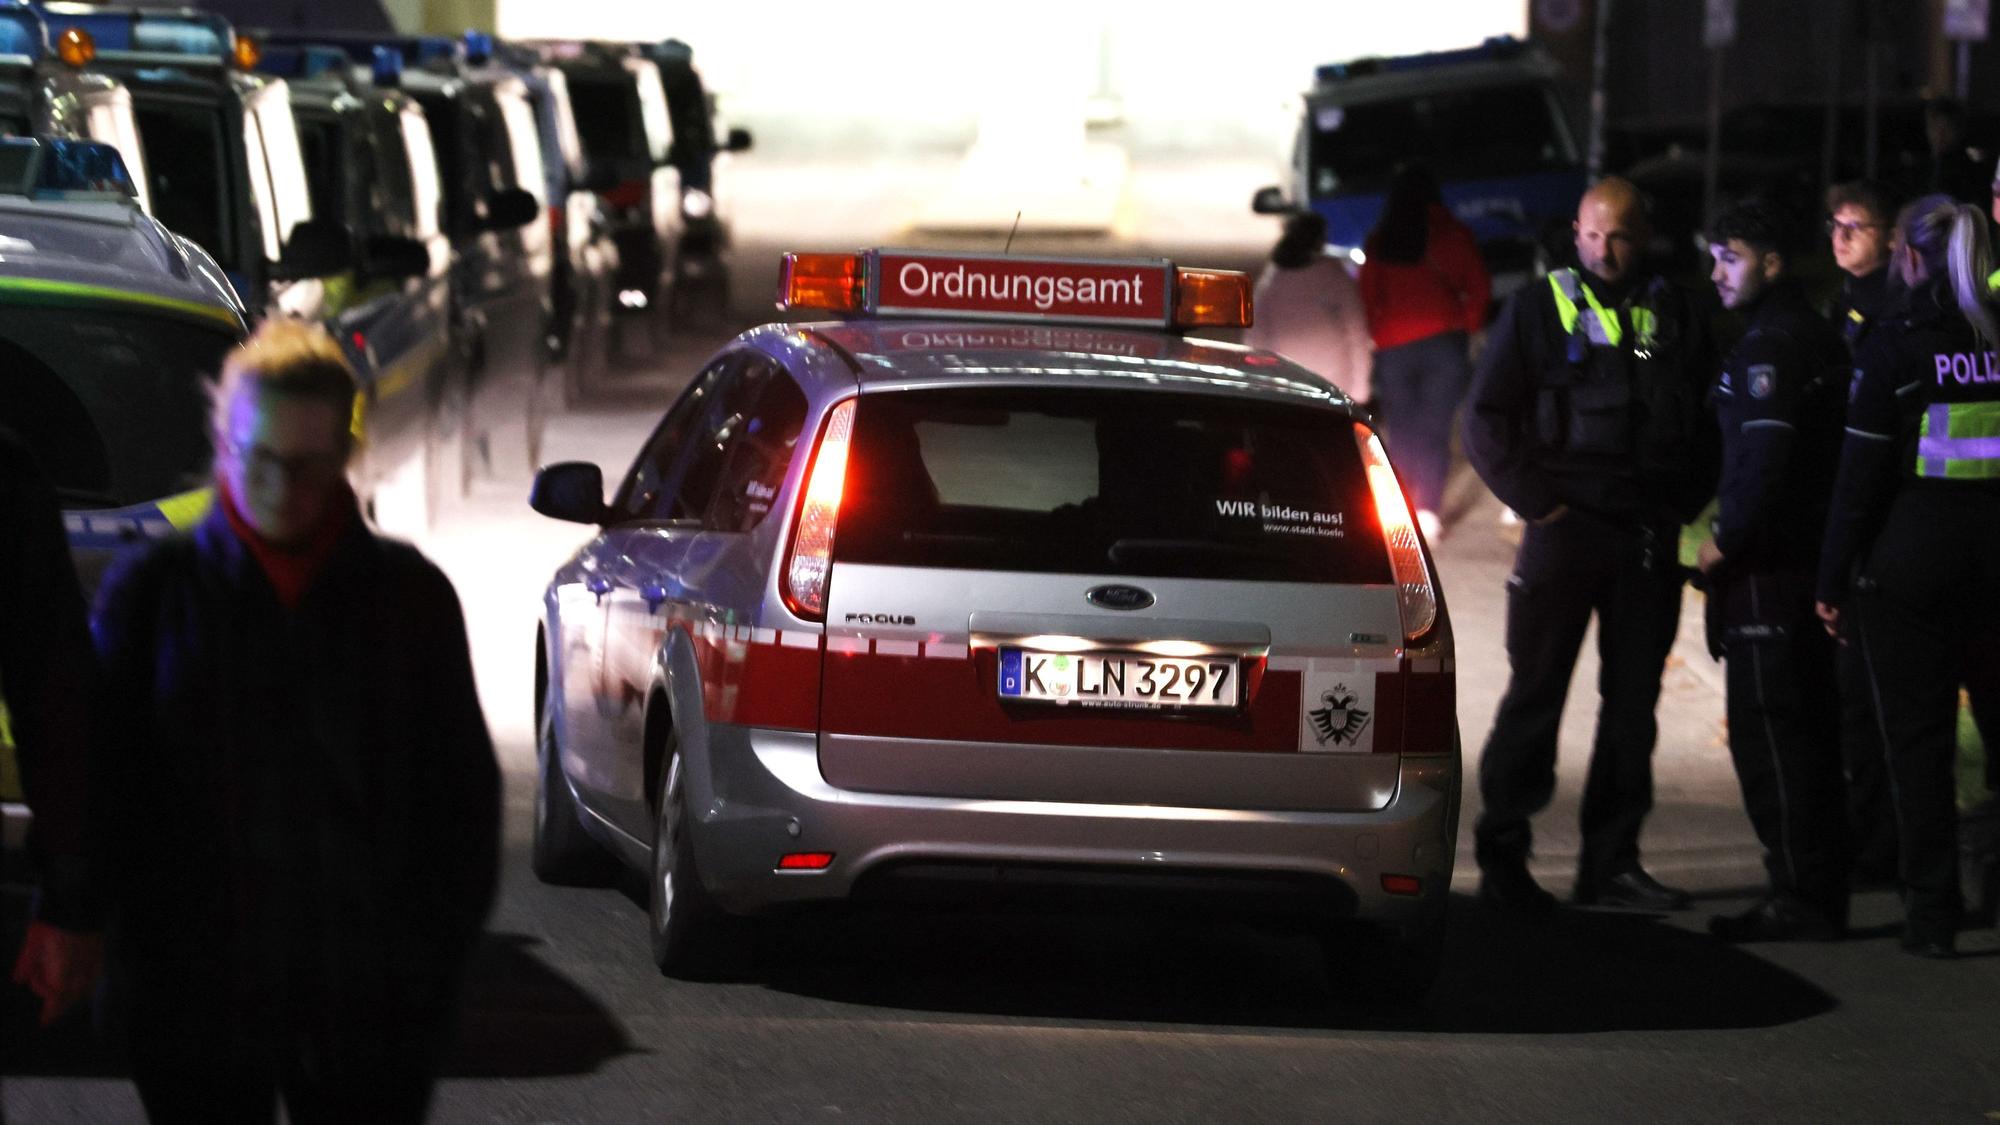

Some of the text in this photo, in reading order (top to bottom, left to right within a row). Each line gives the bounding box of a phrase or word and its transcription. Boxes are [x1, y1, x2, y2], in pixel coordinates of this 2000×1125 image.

[899, 261, 1143, 309] Ordnungsamt
[1215, 499, 1343, 525] WIR bilden aus!
[1006, 677, 1015, 689] D
[1025, 655, 1230, 700] K LN 3297
